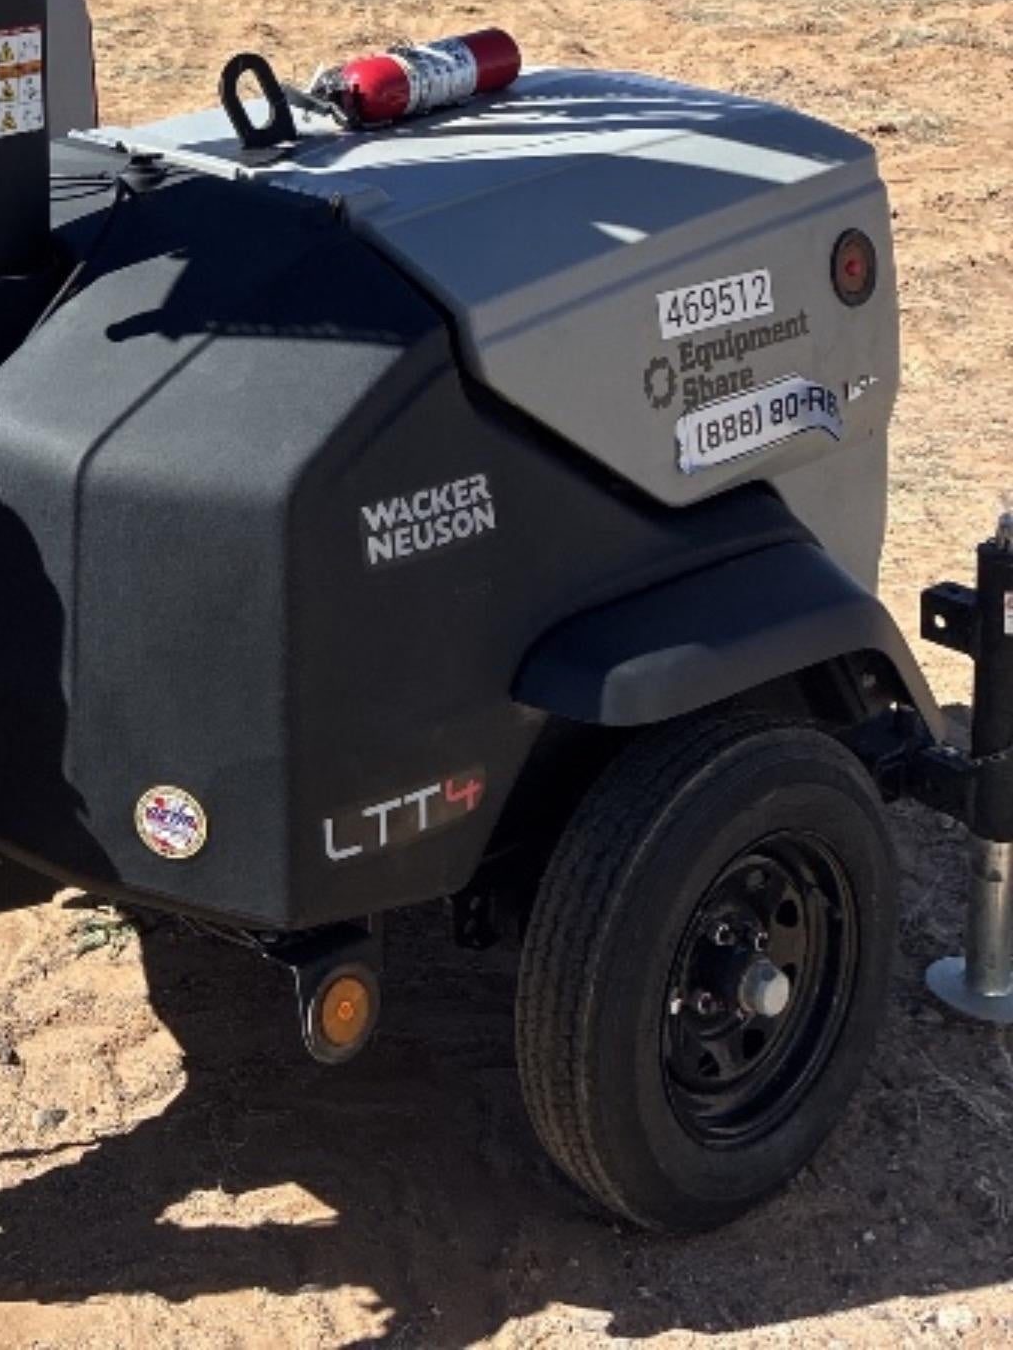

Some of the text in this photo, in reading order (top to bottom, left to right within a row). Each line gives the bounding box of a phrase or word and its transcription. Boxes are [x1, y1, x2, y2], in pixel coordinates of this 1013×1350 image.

[666, 274, 769, 329] 469512
[678, 308, 811, 372] Equipment
[682, 365, 755, 410] Share
[697, 403, 763, 454] (888)
[361, 472, 492, 533] WACKER
[366, 503, 497, 566] NEUSON
[322, 778, 484, 863] LTT4
